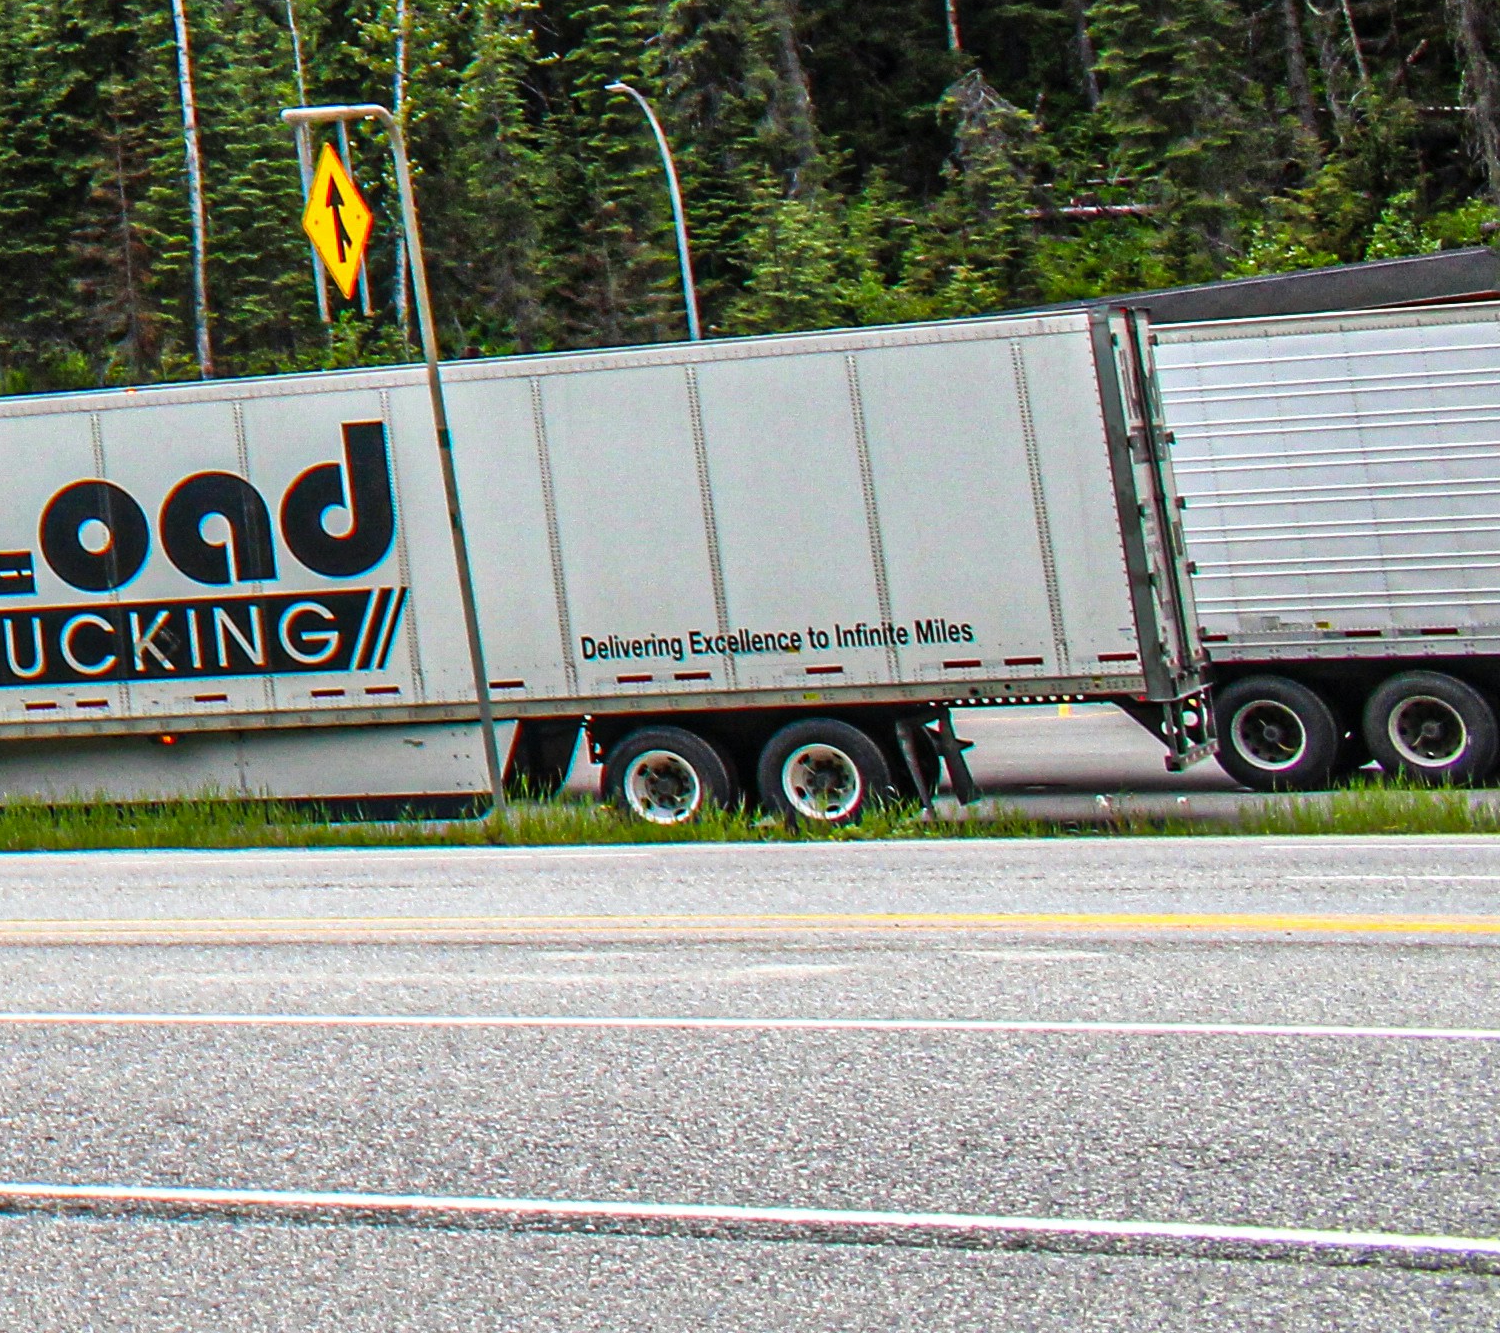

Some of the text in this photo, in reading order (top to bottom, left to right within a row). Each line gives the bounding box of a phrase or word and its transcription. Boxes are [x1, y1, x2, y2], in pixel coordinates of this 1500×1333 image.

[580, 618, 975, 662] Delivering Excellence to Infinite Miles
